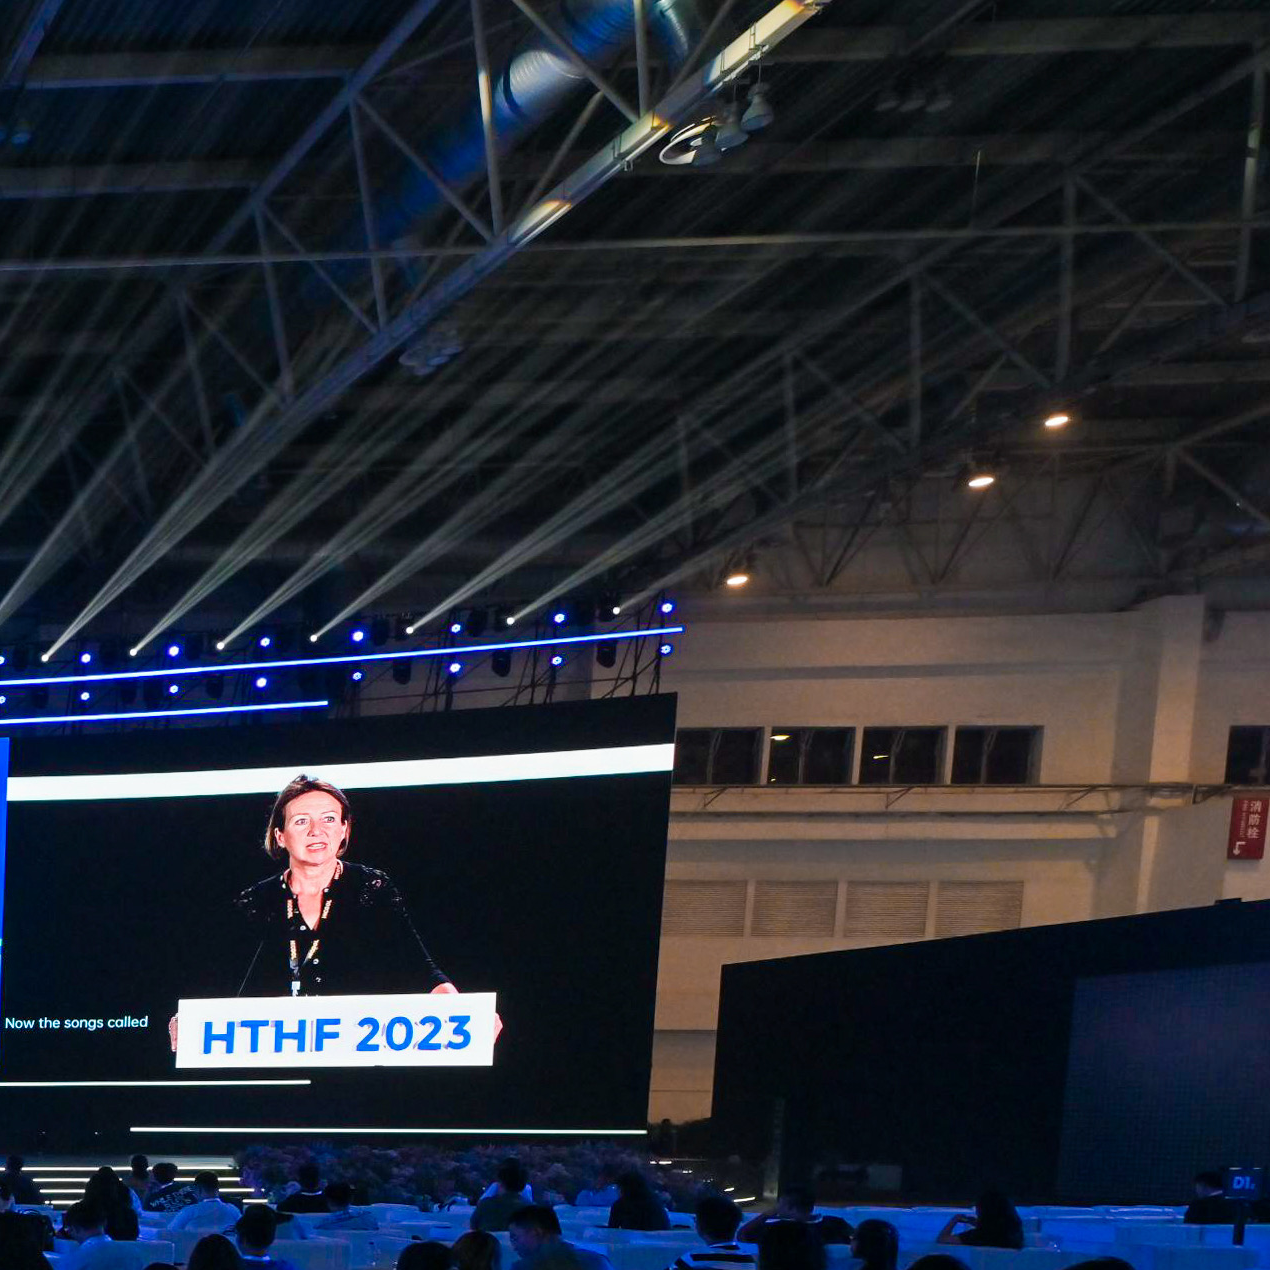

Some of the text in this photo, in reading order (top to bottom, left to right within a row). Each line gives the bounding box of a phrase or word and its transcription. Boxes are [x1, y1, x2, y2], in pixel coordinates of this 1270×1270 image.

[5, 1015, 149, 1031] Now the songs called
[203, 1015, 472, 1055] HTHF 2023
